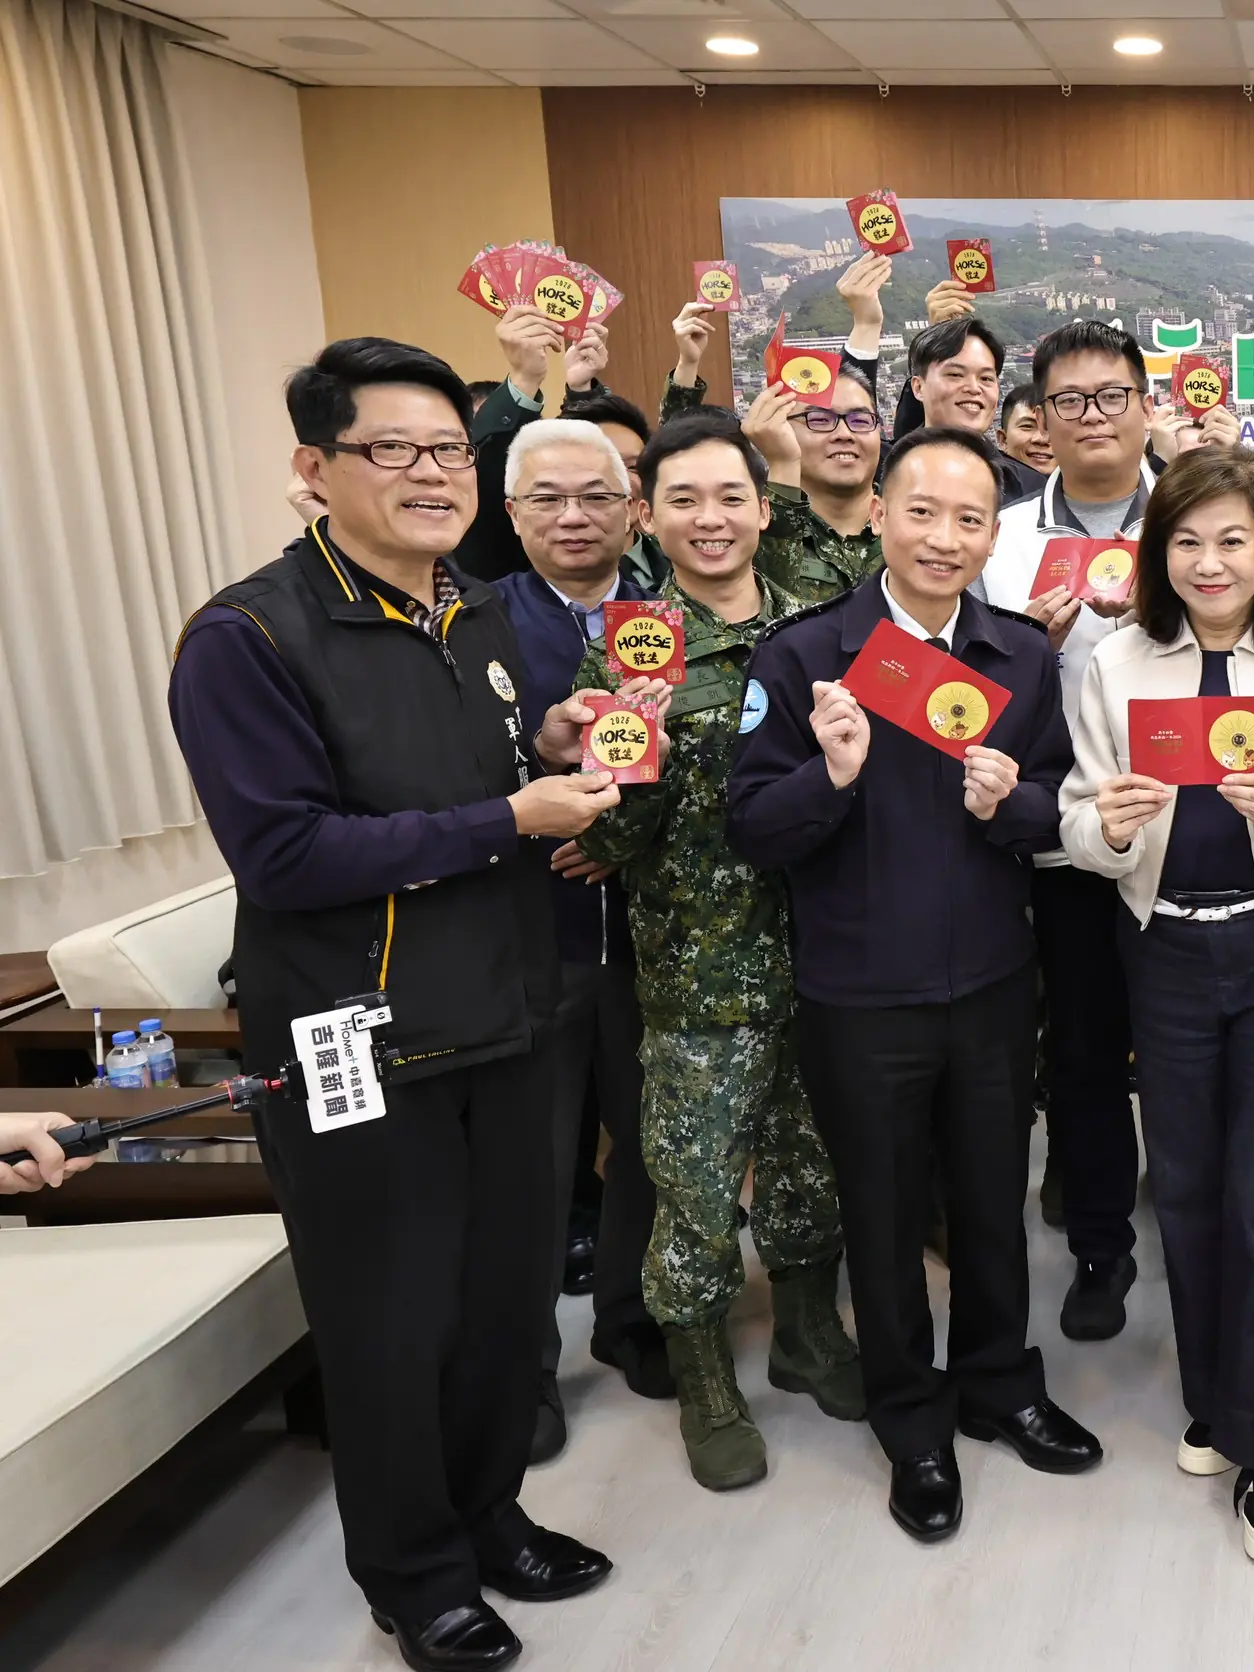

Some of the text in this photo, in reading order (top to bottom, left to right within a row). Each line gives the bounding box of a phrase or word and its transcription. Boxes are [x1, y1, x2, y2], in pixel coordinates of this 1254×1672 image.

[861, 214, 894, 233] HORSE
[956, 260, 985, 271] HORSE
[537, 287, 582, 310] HORSE
[1185, 381, 1220, 395] HORSE
[633, 622, 654, 630] 2026
[617, 634, 671, 650] HORSE
[610, 716, 630, 725] 2026
[593, 729, 646, 746] HORSE
[311, 1025, 349, 1117] 吉隆新聞
